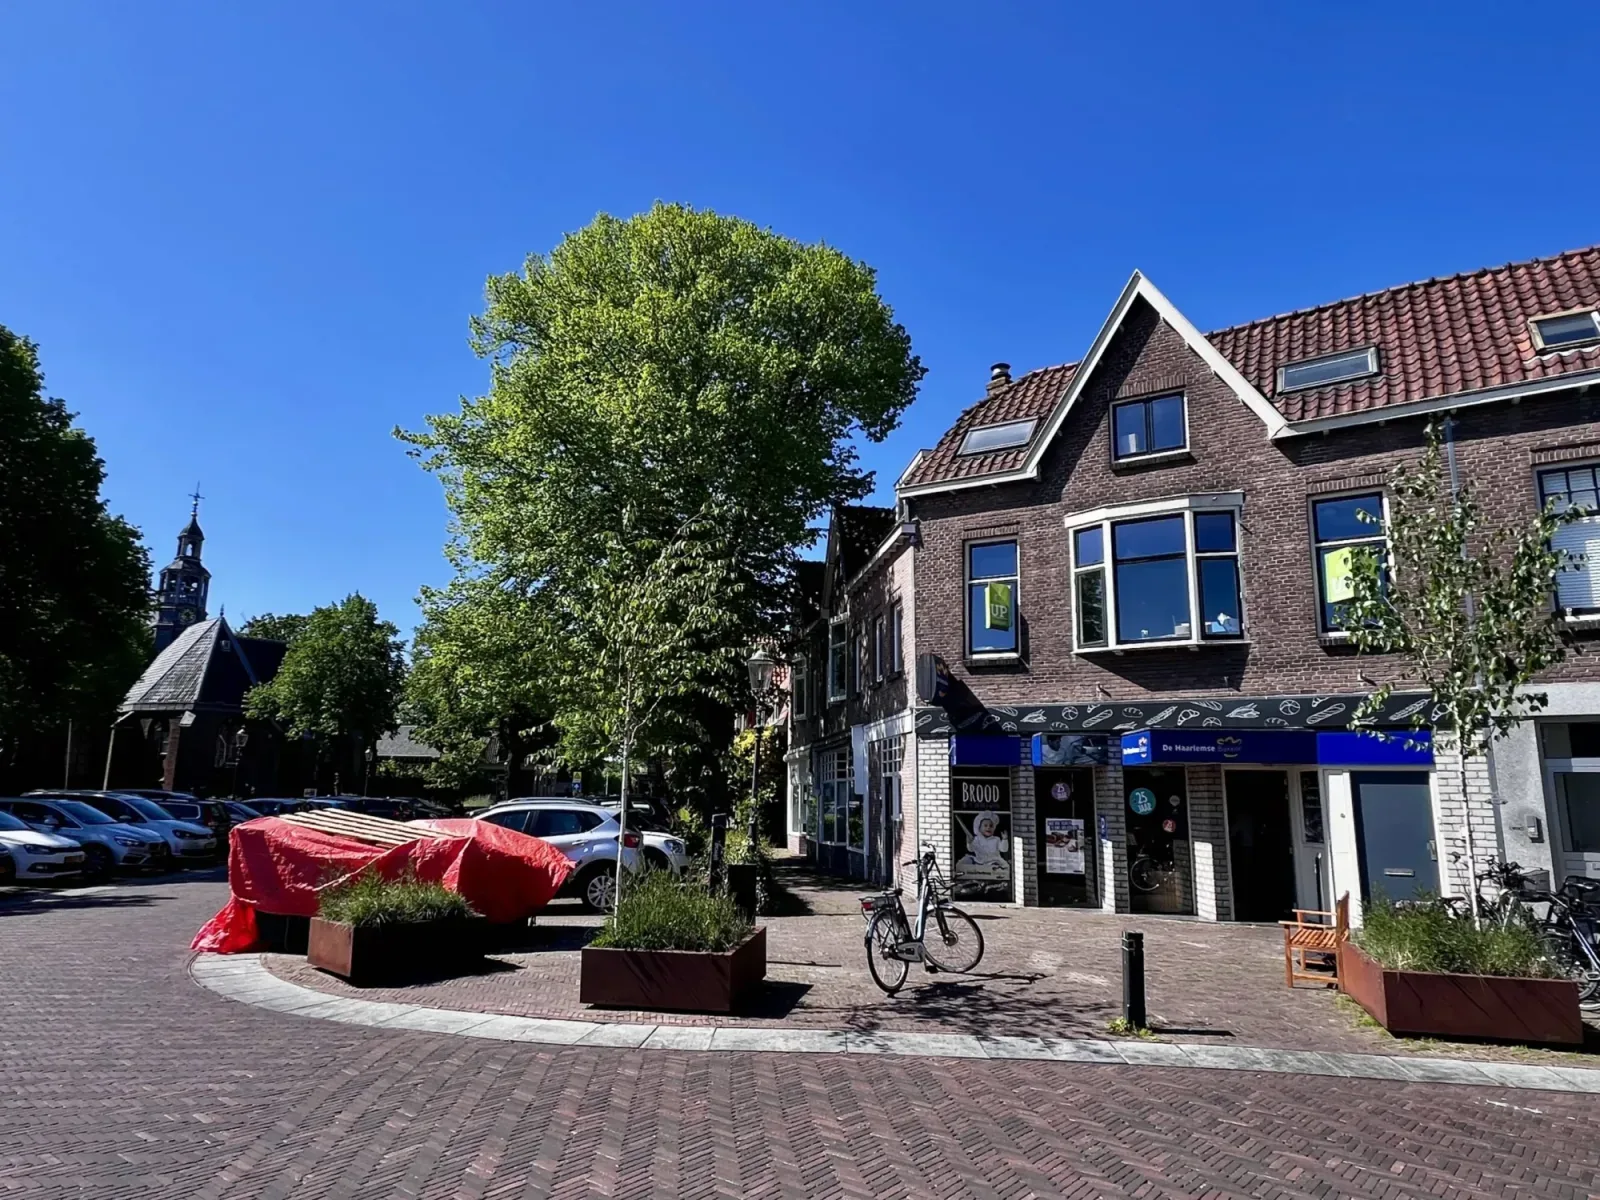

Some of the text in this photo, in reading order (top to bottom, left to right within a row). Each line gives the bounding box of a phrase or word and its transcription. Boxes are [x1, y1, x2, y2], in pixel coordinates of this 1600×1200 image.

[991, 604, 1008, 618] UP
[1162, 744, 1173, 752] De
[1174, 744, 1215, 752] Haarlemse
[1135, 791, 1148, 804] 25
[1137, 802, 1152, 813] JAAR
